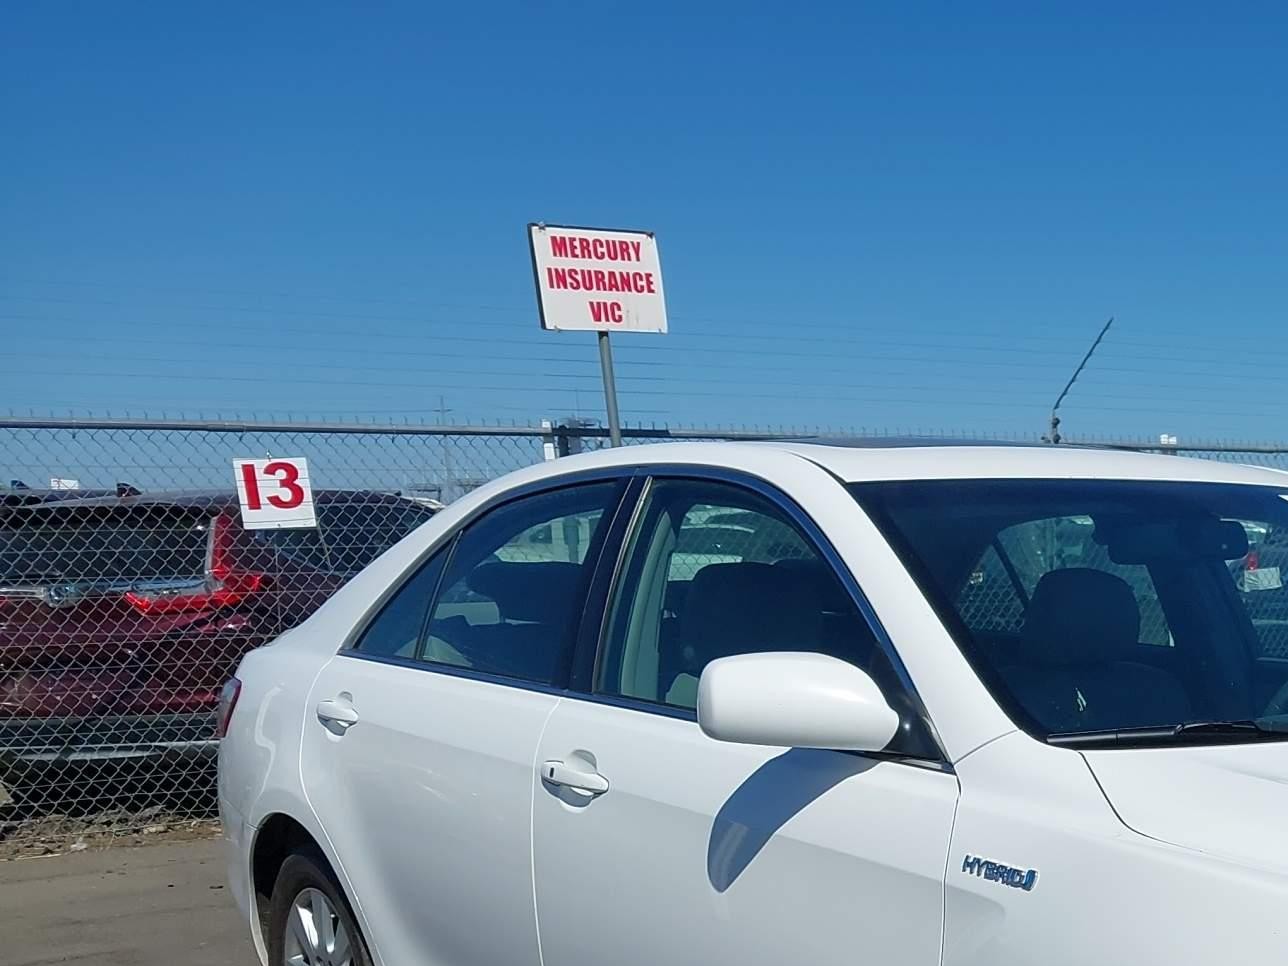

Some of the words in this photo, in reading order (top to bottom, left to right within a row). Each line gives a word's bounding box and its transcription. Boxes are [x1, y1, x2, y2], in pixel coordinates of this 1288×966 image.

[550, 235, 641, 262] MERCURY
[547, 267, 656, 294] INSURANCE
[588, 301, 623, 323] VIC
[241, 461, 304, 511] 13
[962, 854, 1027, 889] HYBRID
